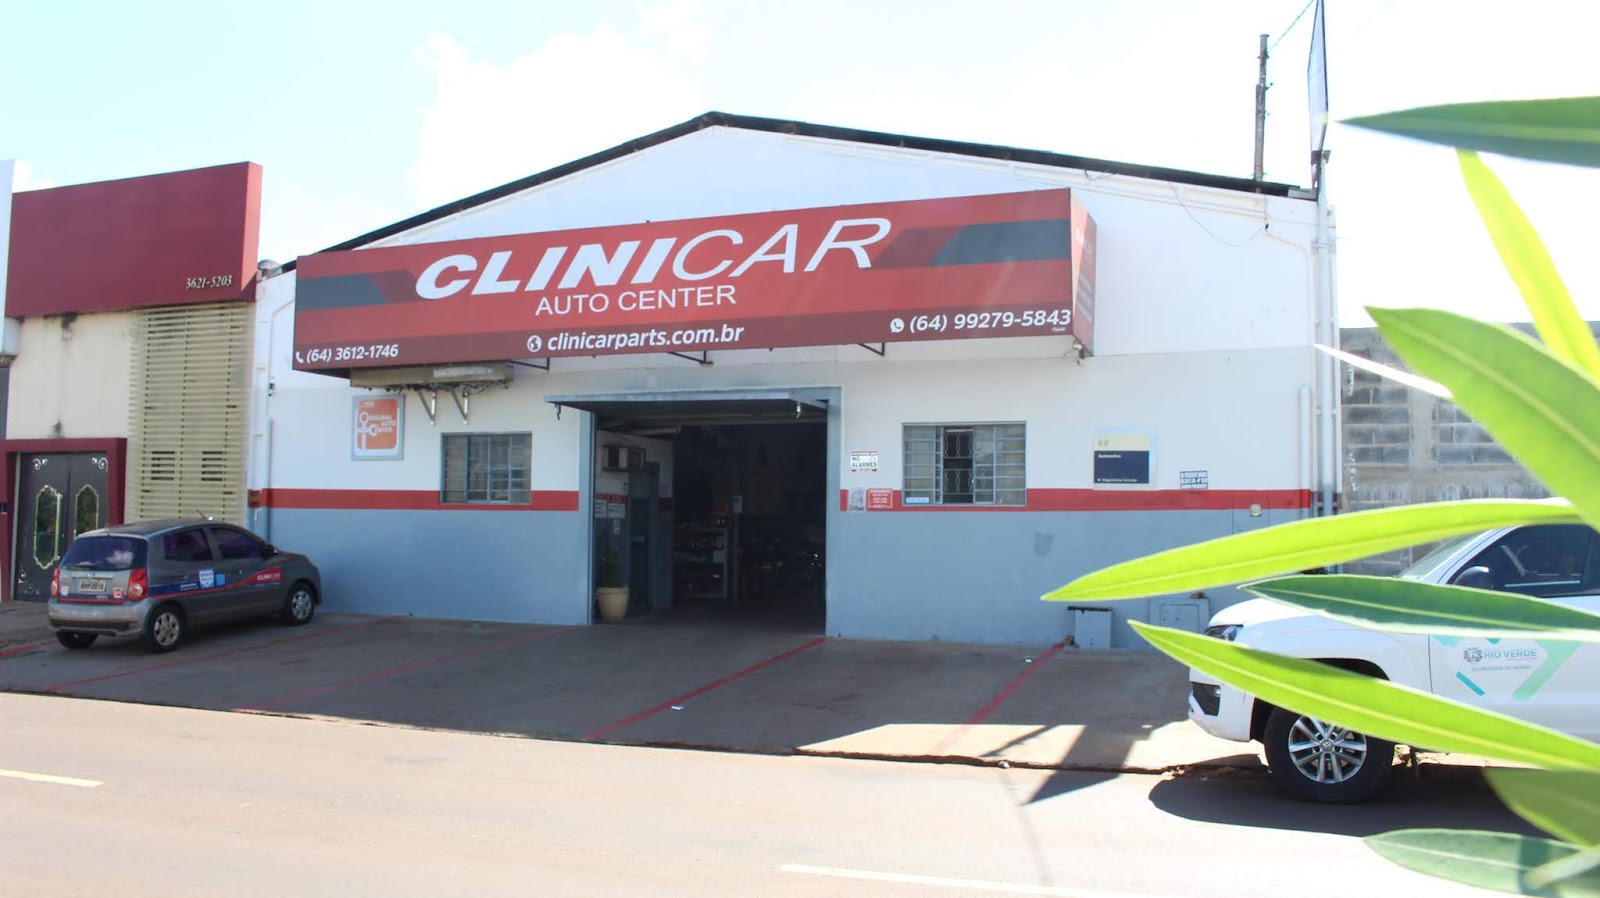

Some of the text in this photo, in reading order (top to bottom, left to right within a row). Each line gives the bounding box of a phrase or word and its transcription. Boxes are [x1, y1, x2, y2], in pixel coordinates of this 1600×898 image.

[415, 217, 892, 300] CLINICAR
[185, 275, 232, 289] 3621-5203
[535, 284, 737, 316] AUTO CENTER
[910, 309, 1072, 333] (64) 99279-5843
[547, 323, 745, 351] clinicarparts.com.br
[306, 344, 399, 364] (64) 3612-1746
[1483, 650, 1502, 659] RIO
[1503, 648, 1537, 658] VERDE
